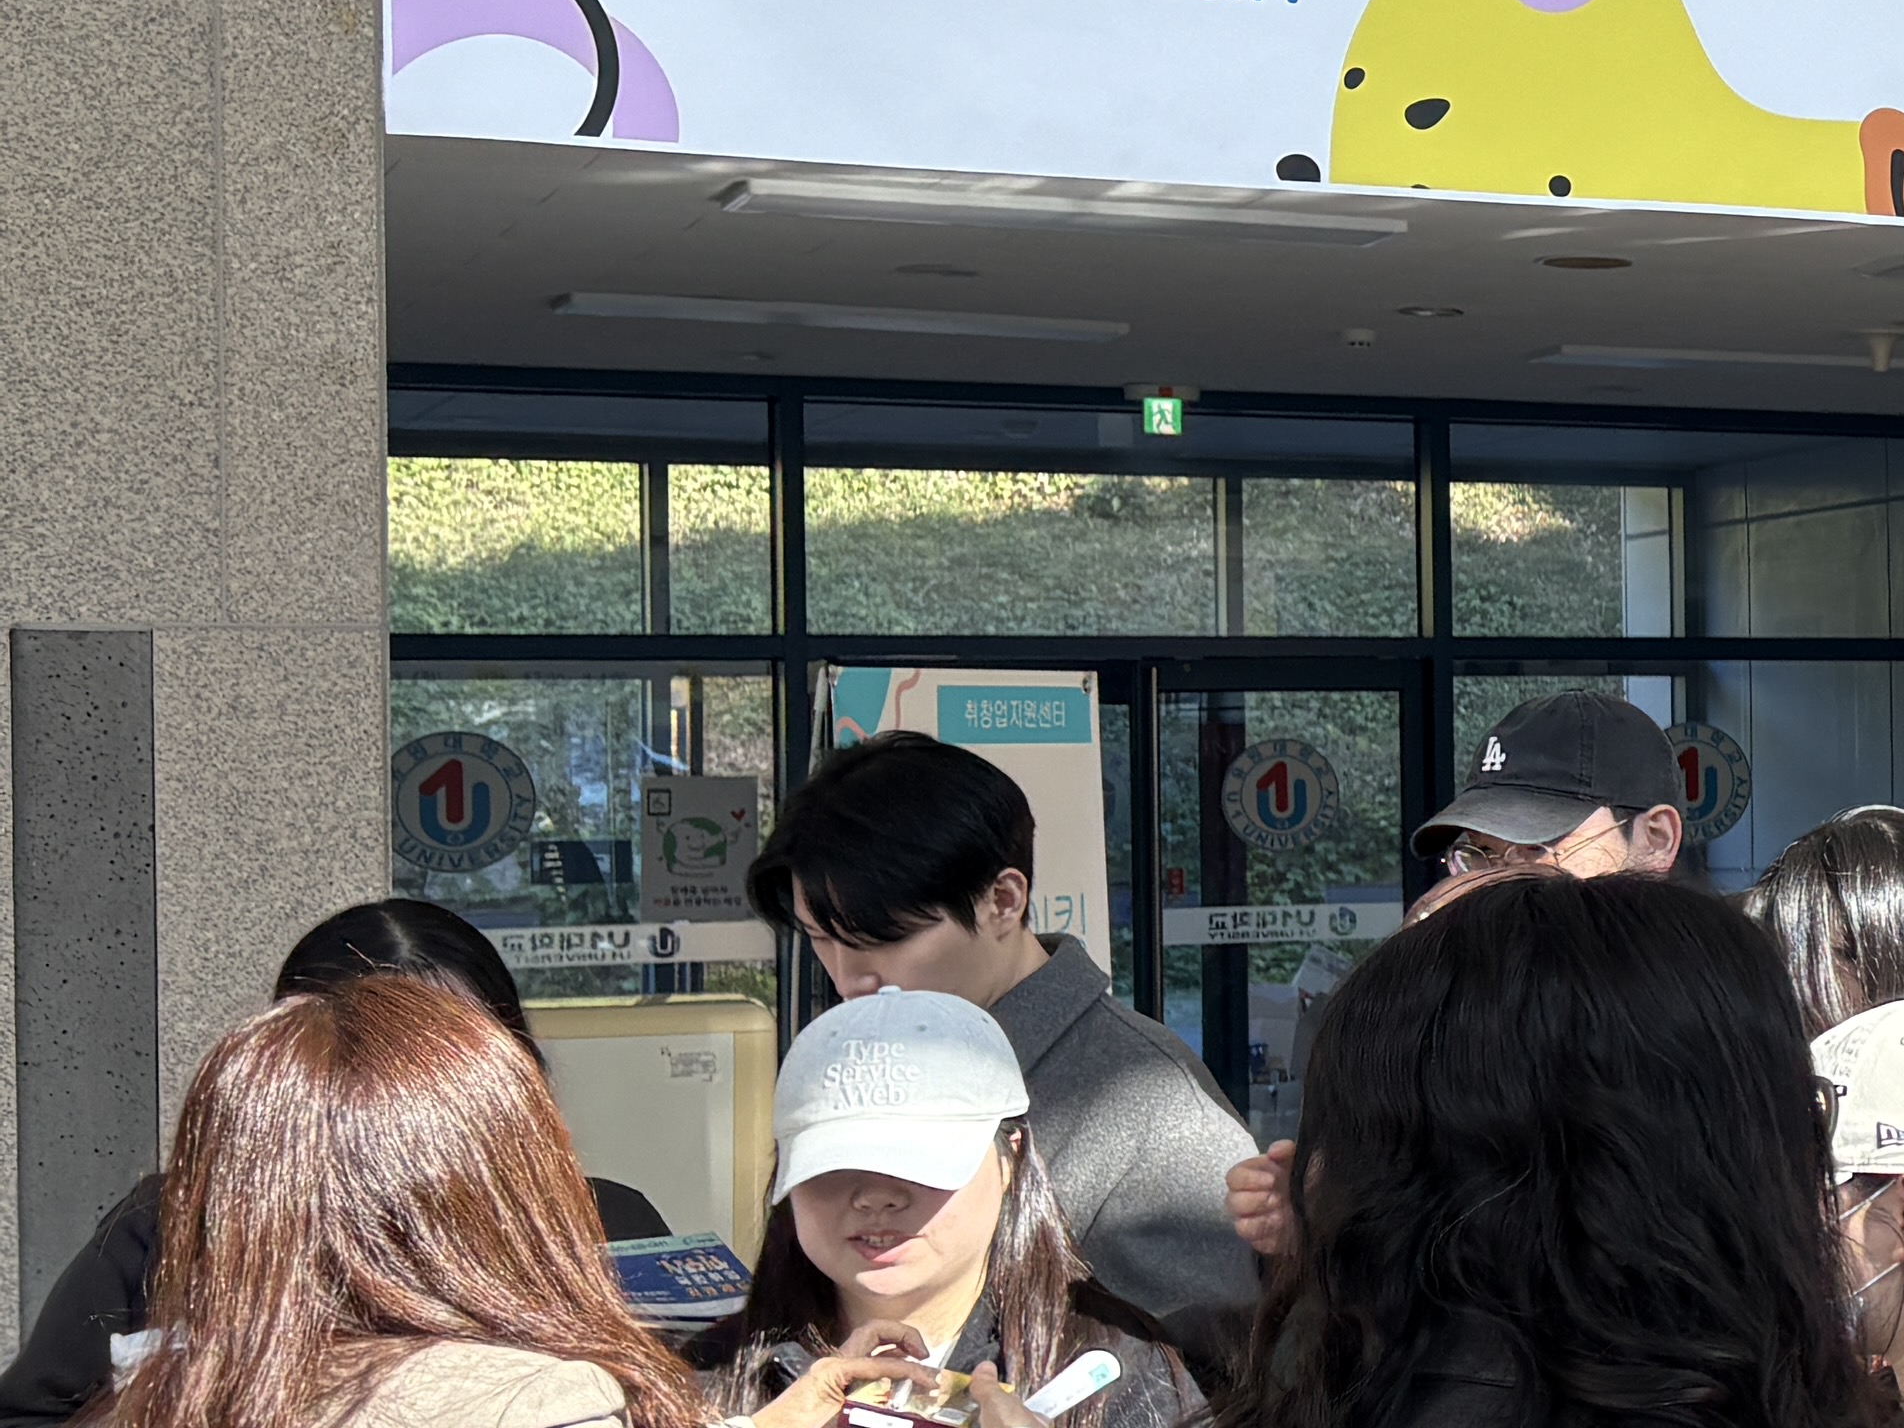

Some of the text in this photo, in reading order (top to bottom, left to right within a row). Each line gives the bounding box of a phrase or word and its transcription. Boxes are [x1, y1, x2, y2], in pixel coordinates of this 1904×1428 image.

[964, 698, 1067, 730] 취창업지원센터
[1481, 735, 1507, 772] LA
[841, 1038, 906, 1064] Type
[822, 1056, 922, 1090] Service
[833, 1080, 907, 1112] Web
